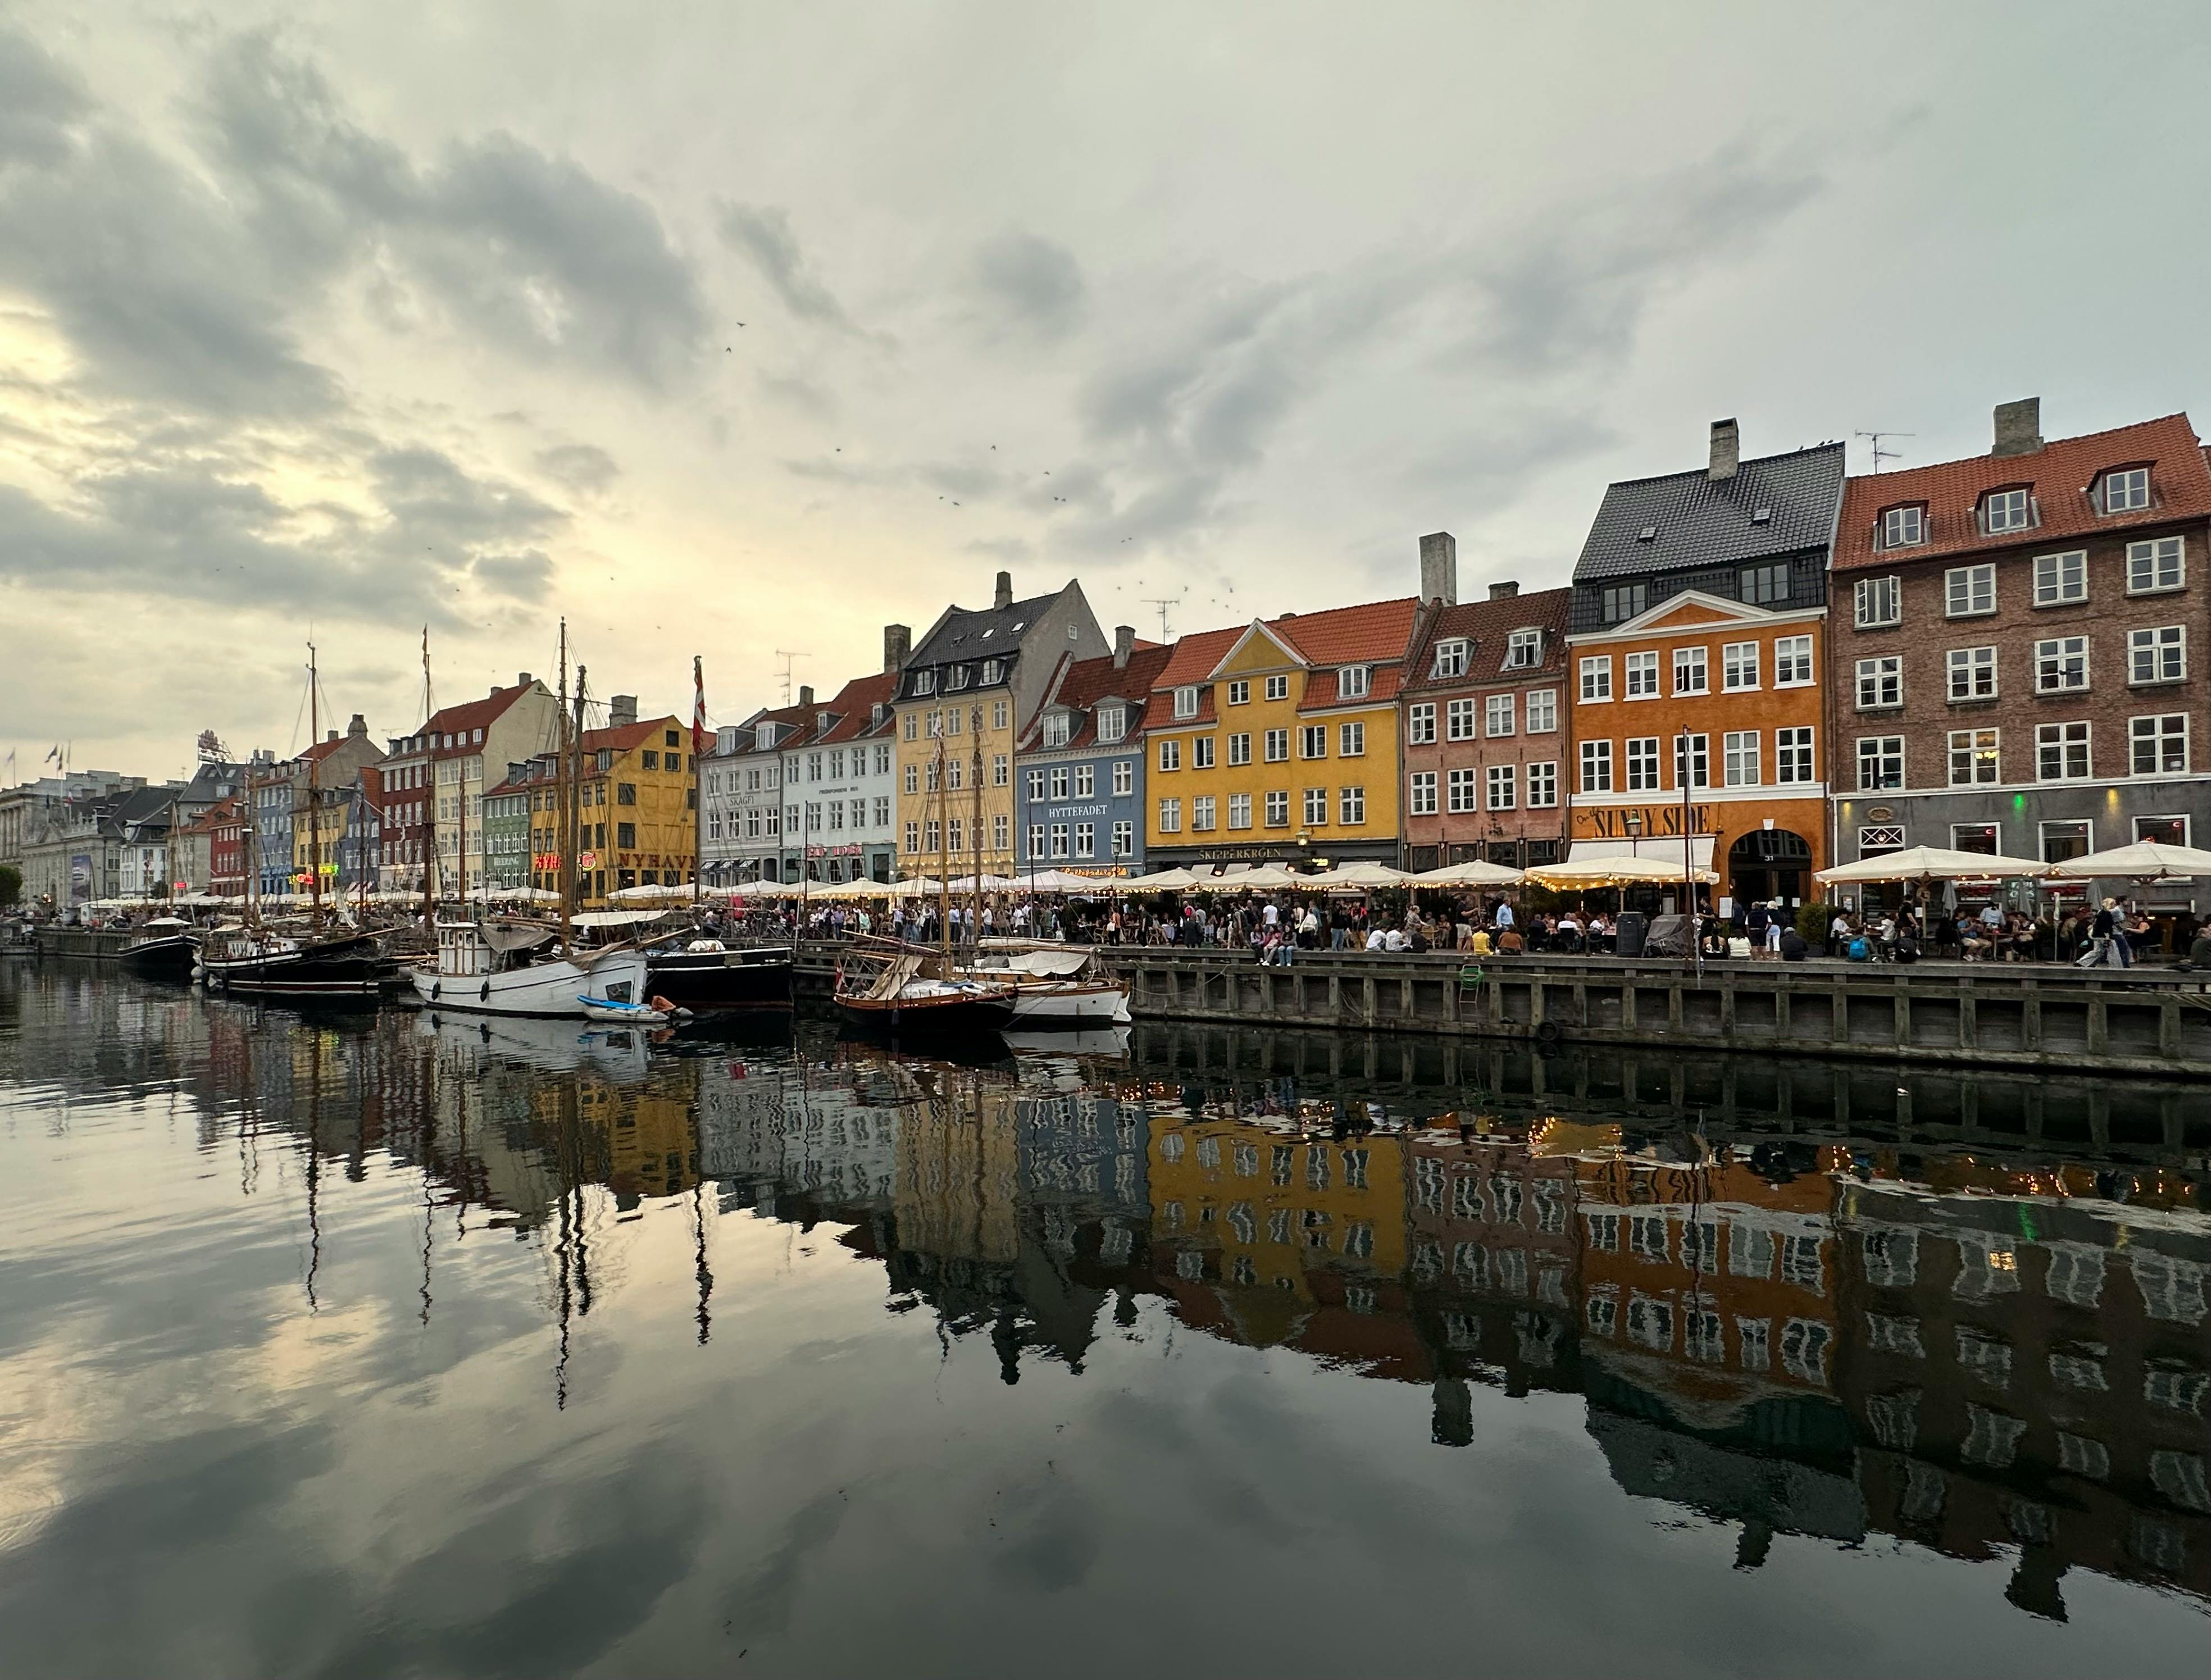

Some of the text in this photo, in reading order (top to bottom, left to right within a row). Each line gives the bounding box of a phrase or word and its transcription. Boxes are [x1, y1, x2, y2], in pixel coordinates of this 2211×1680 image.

[1049, 804, 1107, 818] HYTTEFADET
[1595, 808, 1657, 837] SUNNY
[1663, 805, 1709, 835] SIDE
